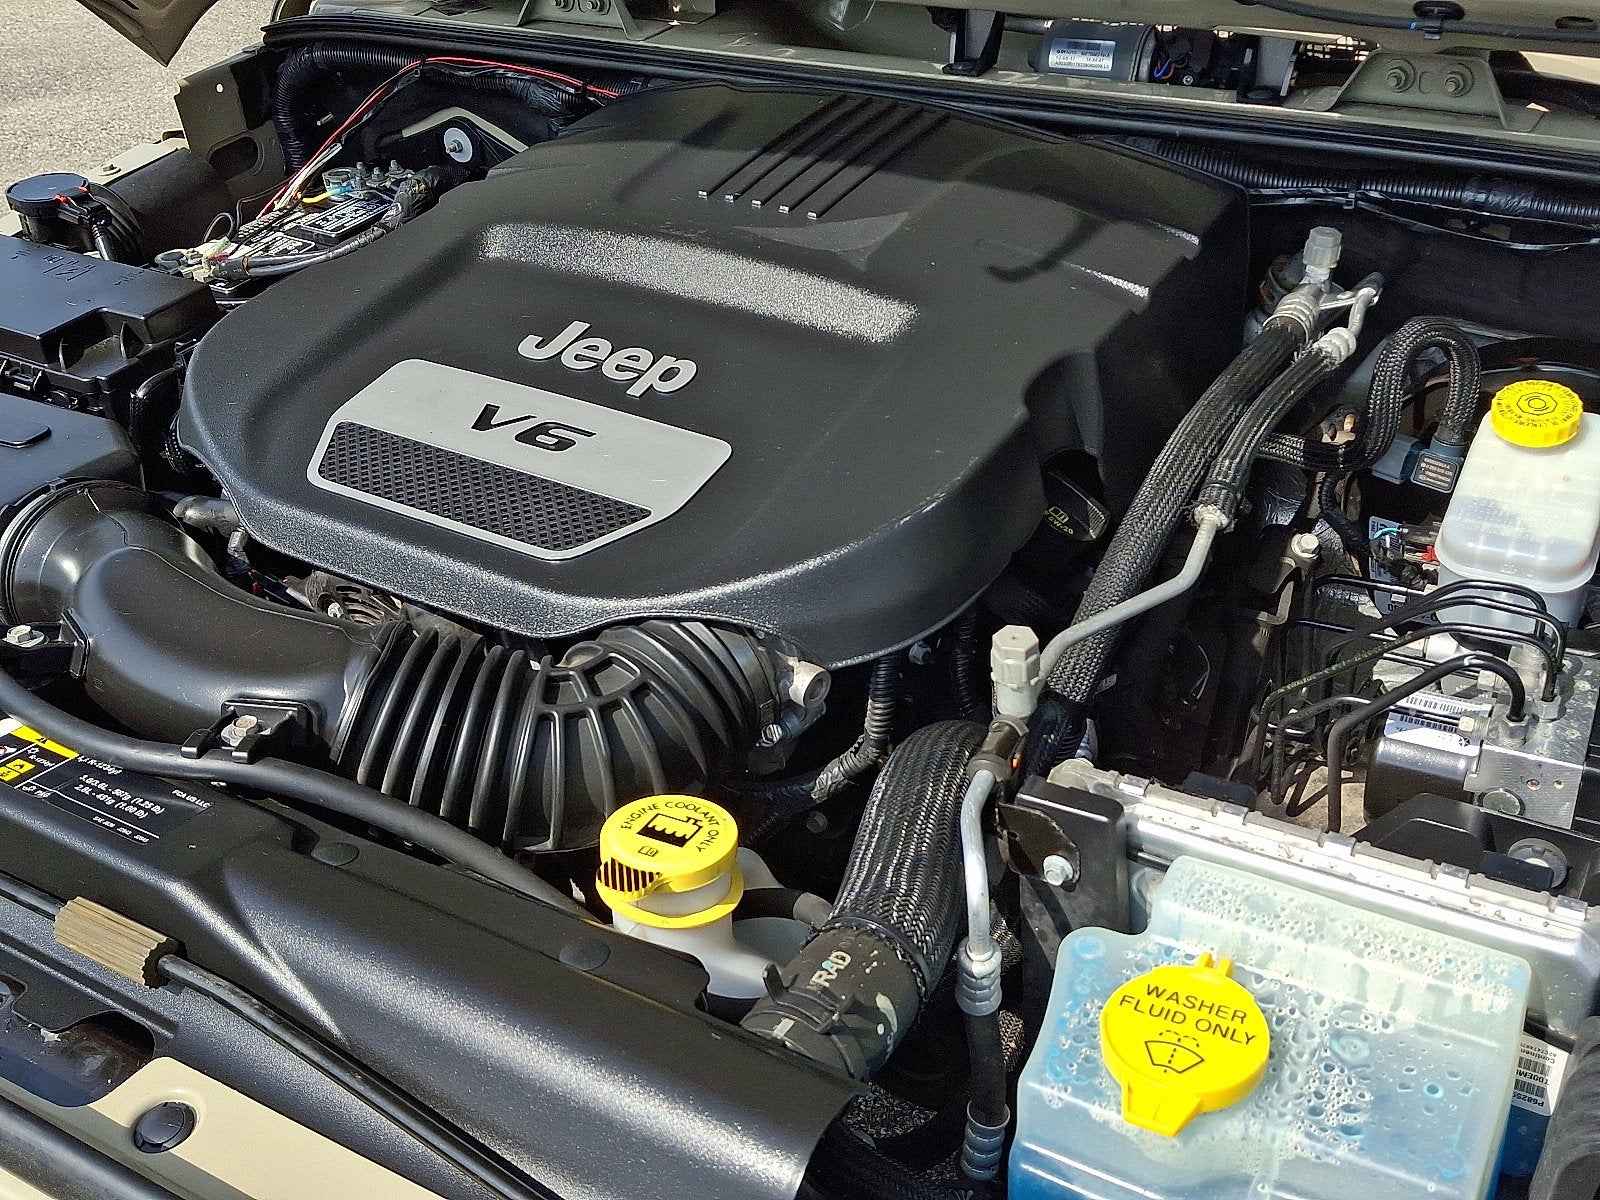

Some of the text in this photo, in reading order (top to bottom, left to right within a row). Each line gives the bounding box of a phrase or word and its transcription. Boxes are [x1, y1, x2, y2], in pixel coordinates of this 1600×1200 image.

[517, 320, 698, 399] Jeep
[470, 402, 598, 453] V6
[171, 789, 187, 800] FCA
[620, 801, 720, 853] ENGINE COOLANT ONLY
[1119, 993, 1257, 1046] FLUID ONLY
[1146, 983, 1248, 1025] WASHER
